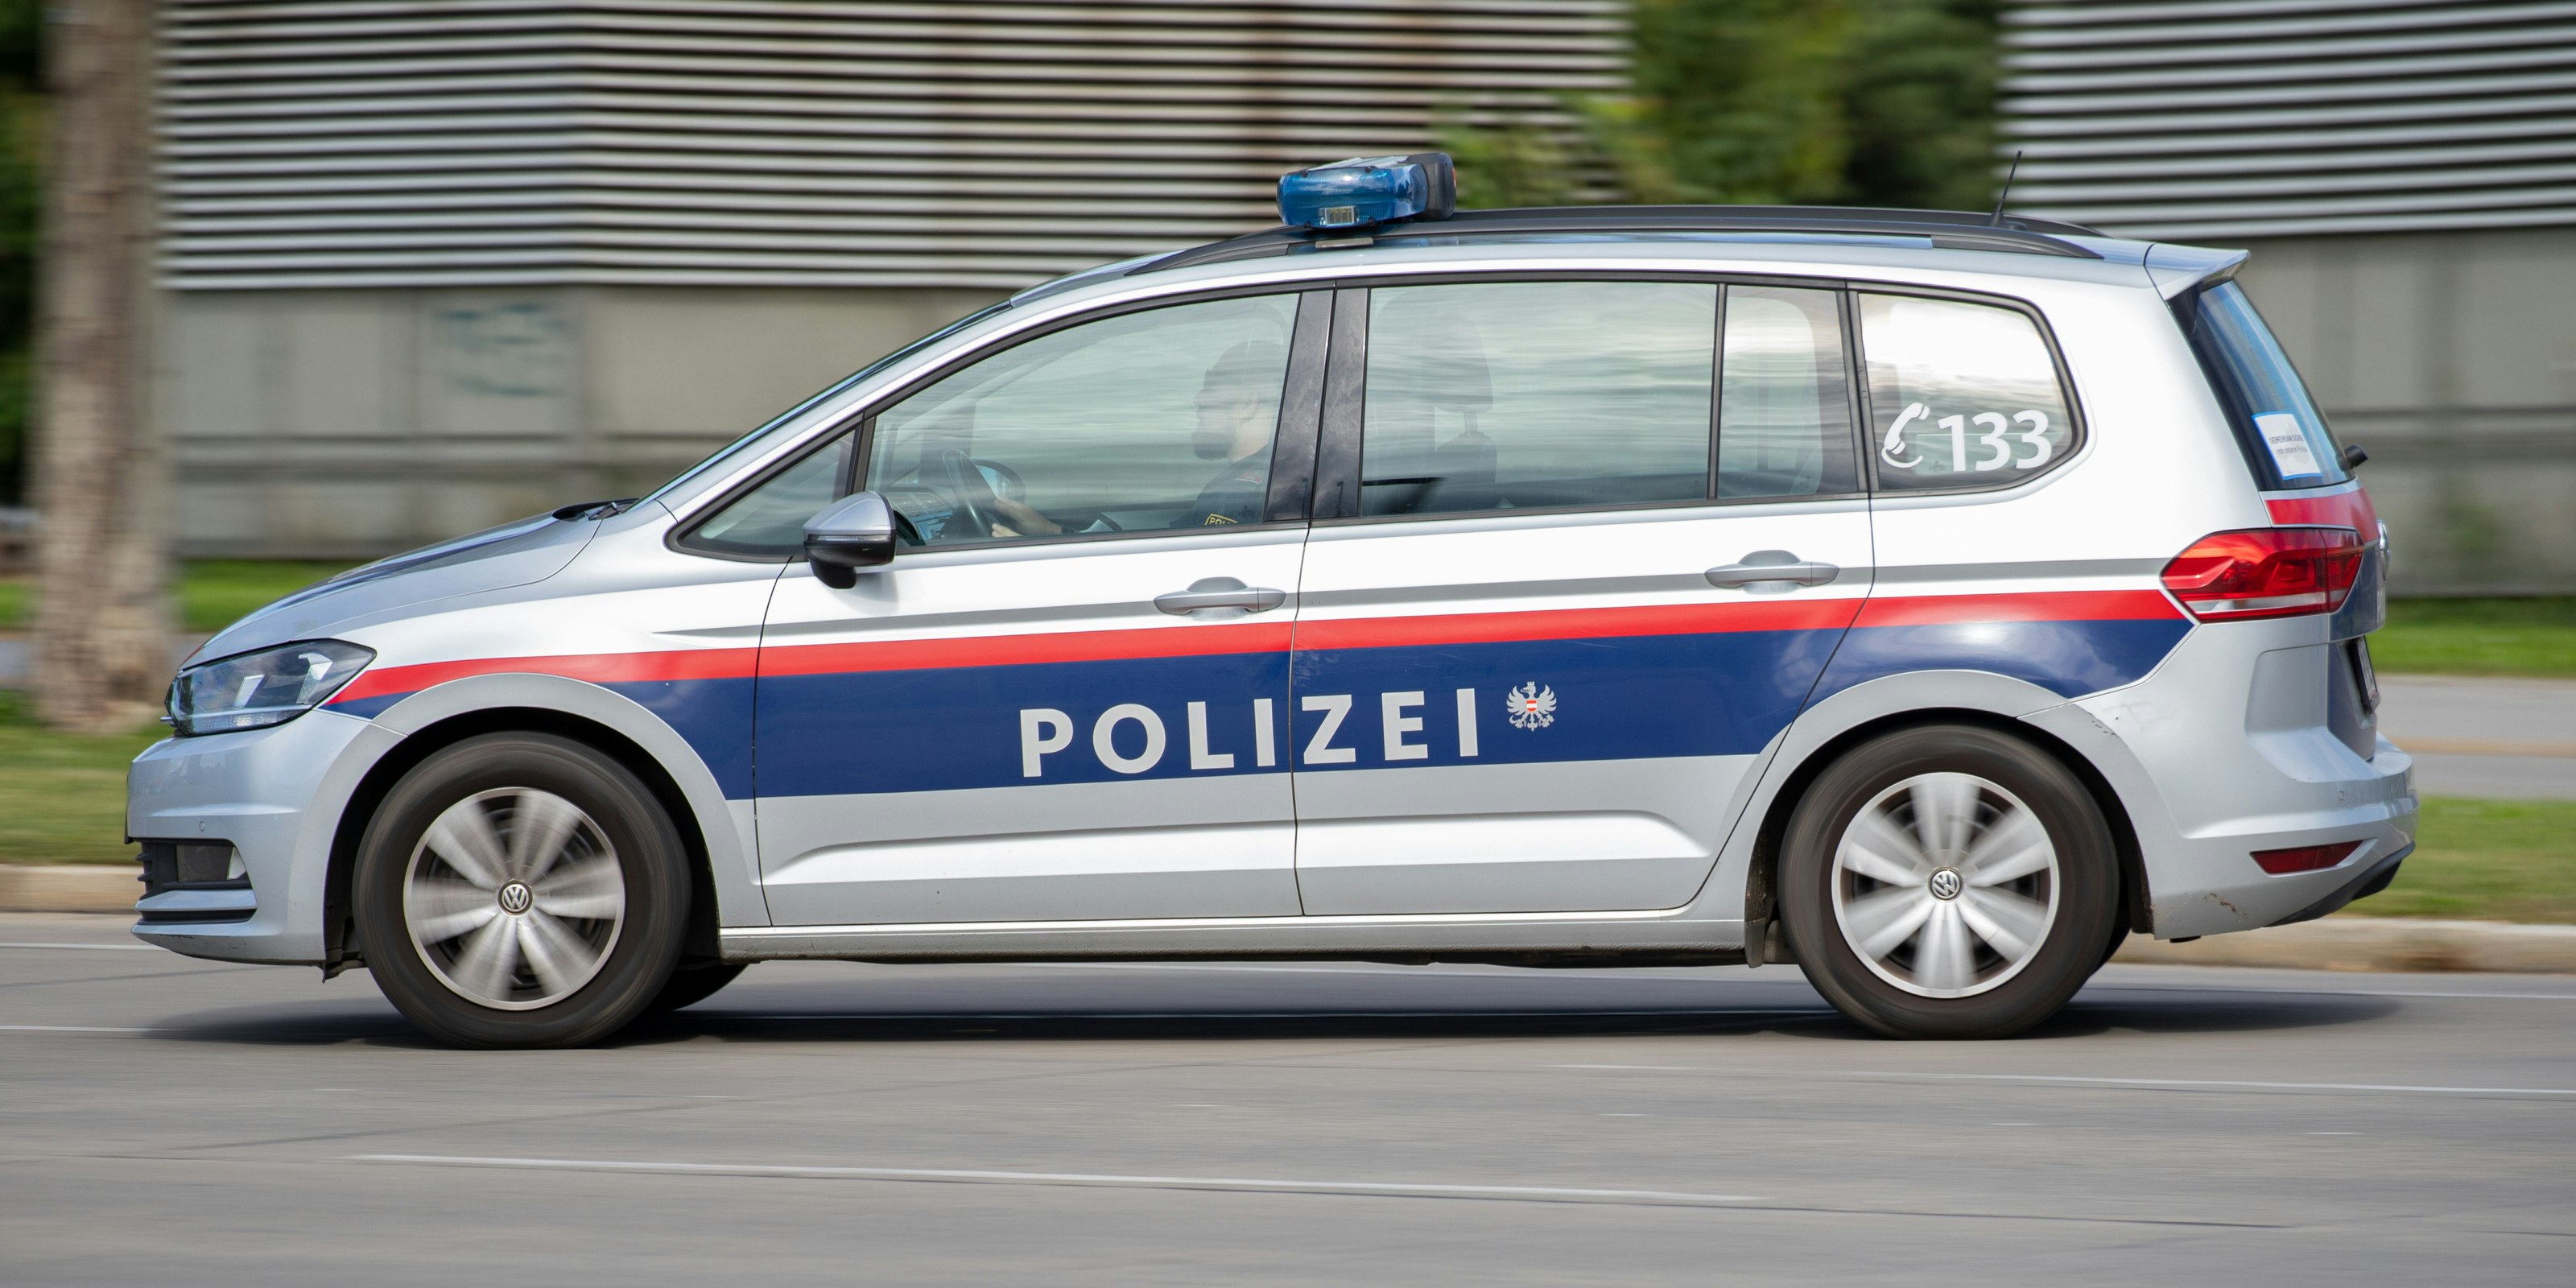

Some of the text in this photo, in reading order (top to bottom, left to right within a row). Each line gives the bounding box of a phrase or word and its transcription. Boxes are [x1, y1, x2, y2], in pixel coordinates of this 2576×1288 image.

[1938, 410, 2052, 472] 133
[1020, 687, 1479, 778] POLIZEI
[502, 883, 530, 912] VW
[1931, 869, 1961, 899] VW
